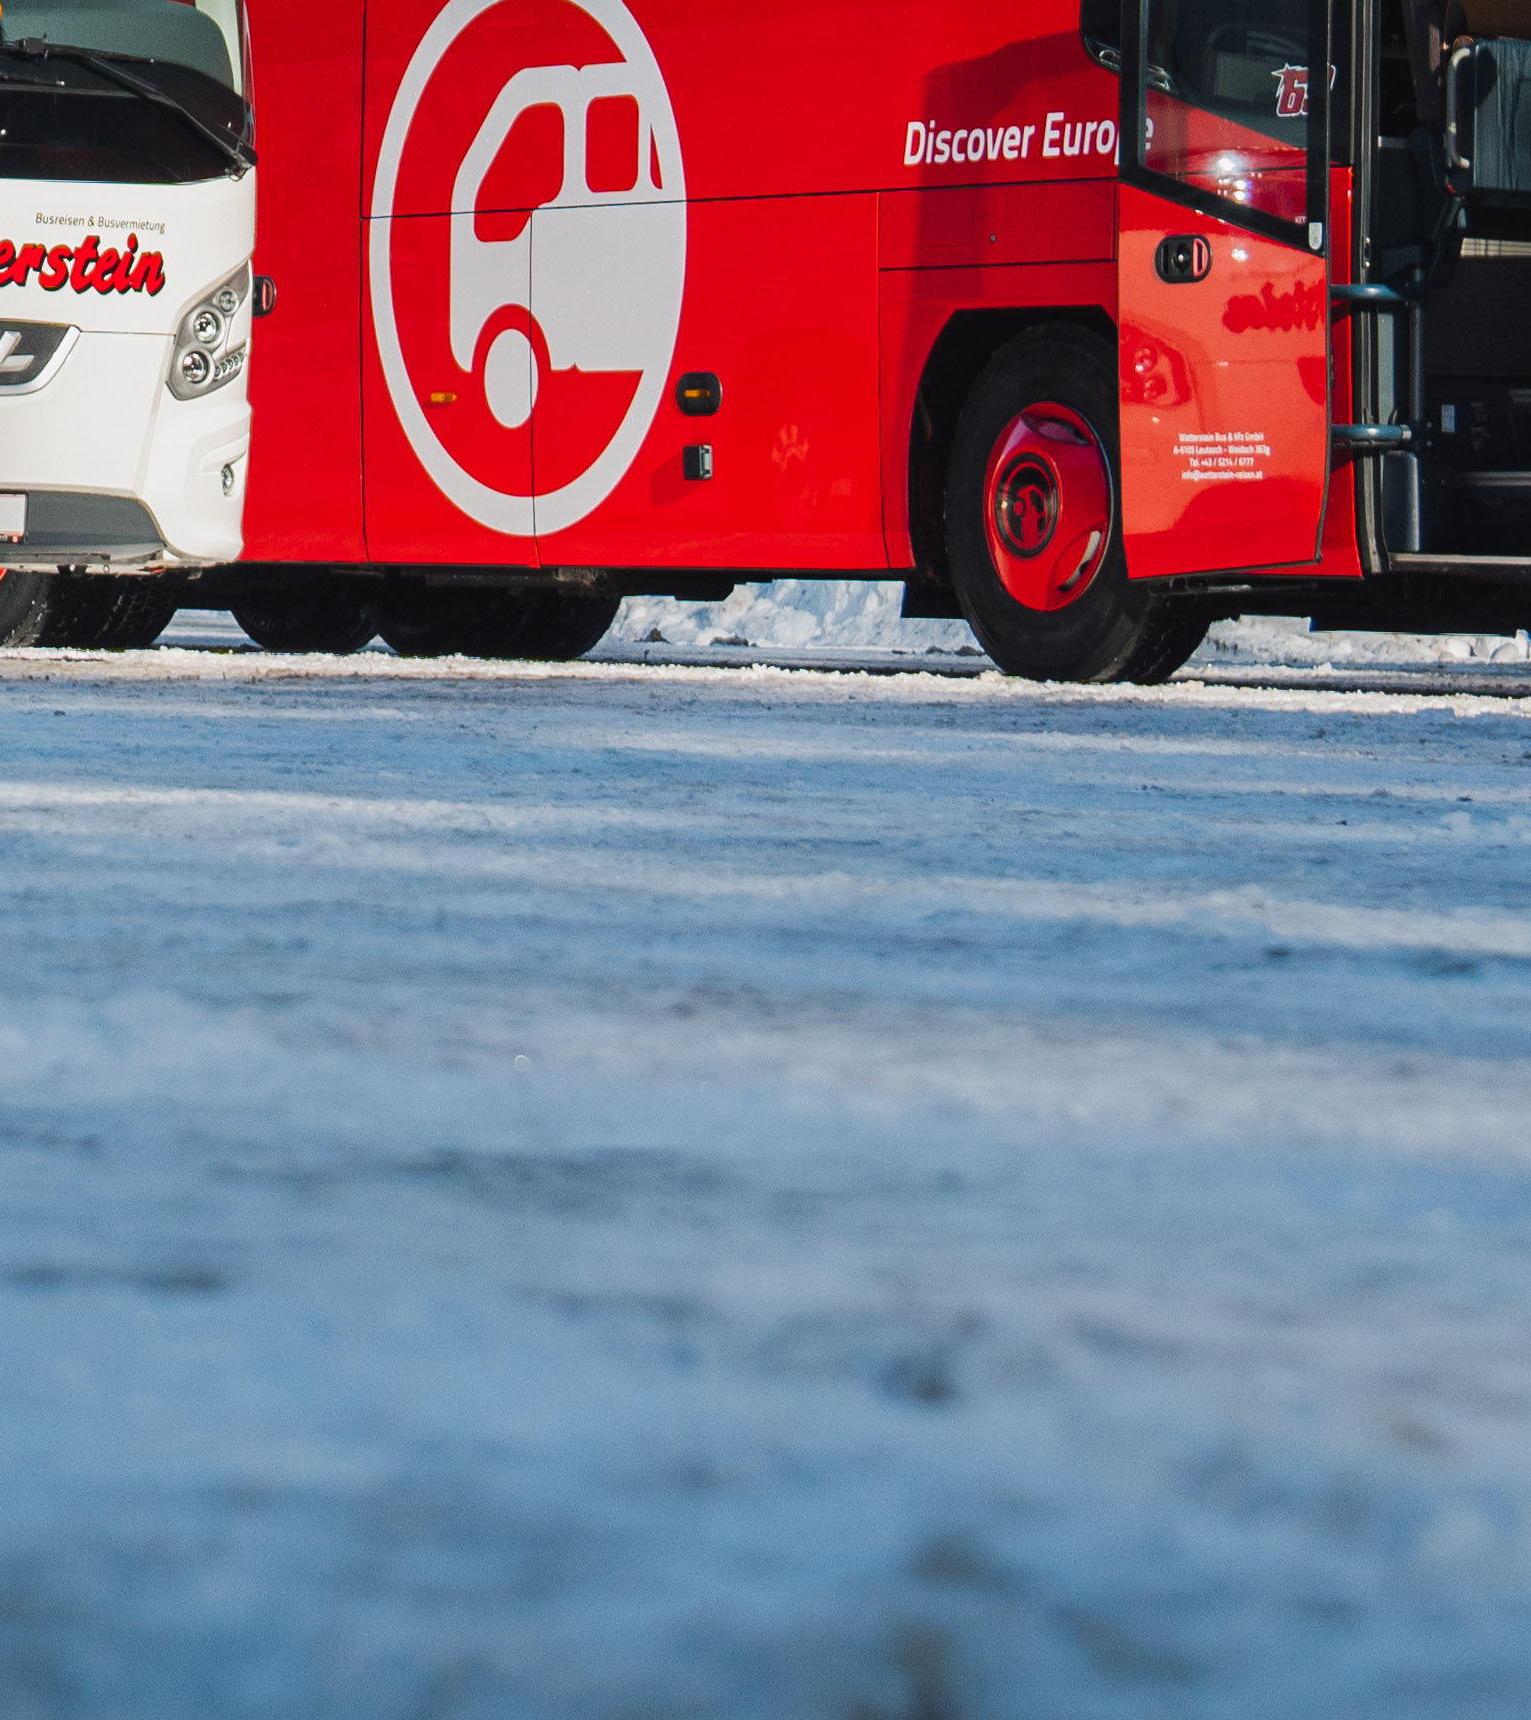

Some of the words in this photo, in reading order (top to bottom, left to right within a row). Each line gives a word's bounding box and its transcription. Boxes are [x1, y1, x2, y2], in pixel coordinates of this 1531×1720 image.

[903, 119, 1036, 166] Discover
[1042, 111, 1155, 167] Euroe
[34, 212, 85, 227] Busreisen
[87, 216, 95, 227] &
[97, 216, 166, 235] Busvermietung
